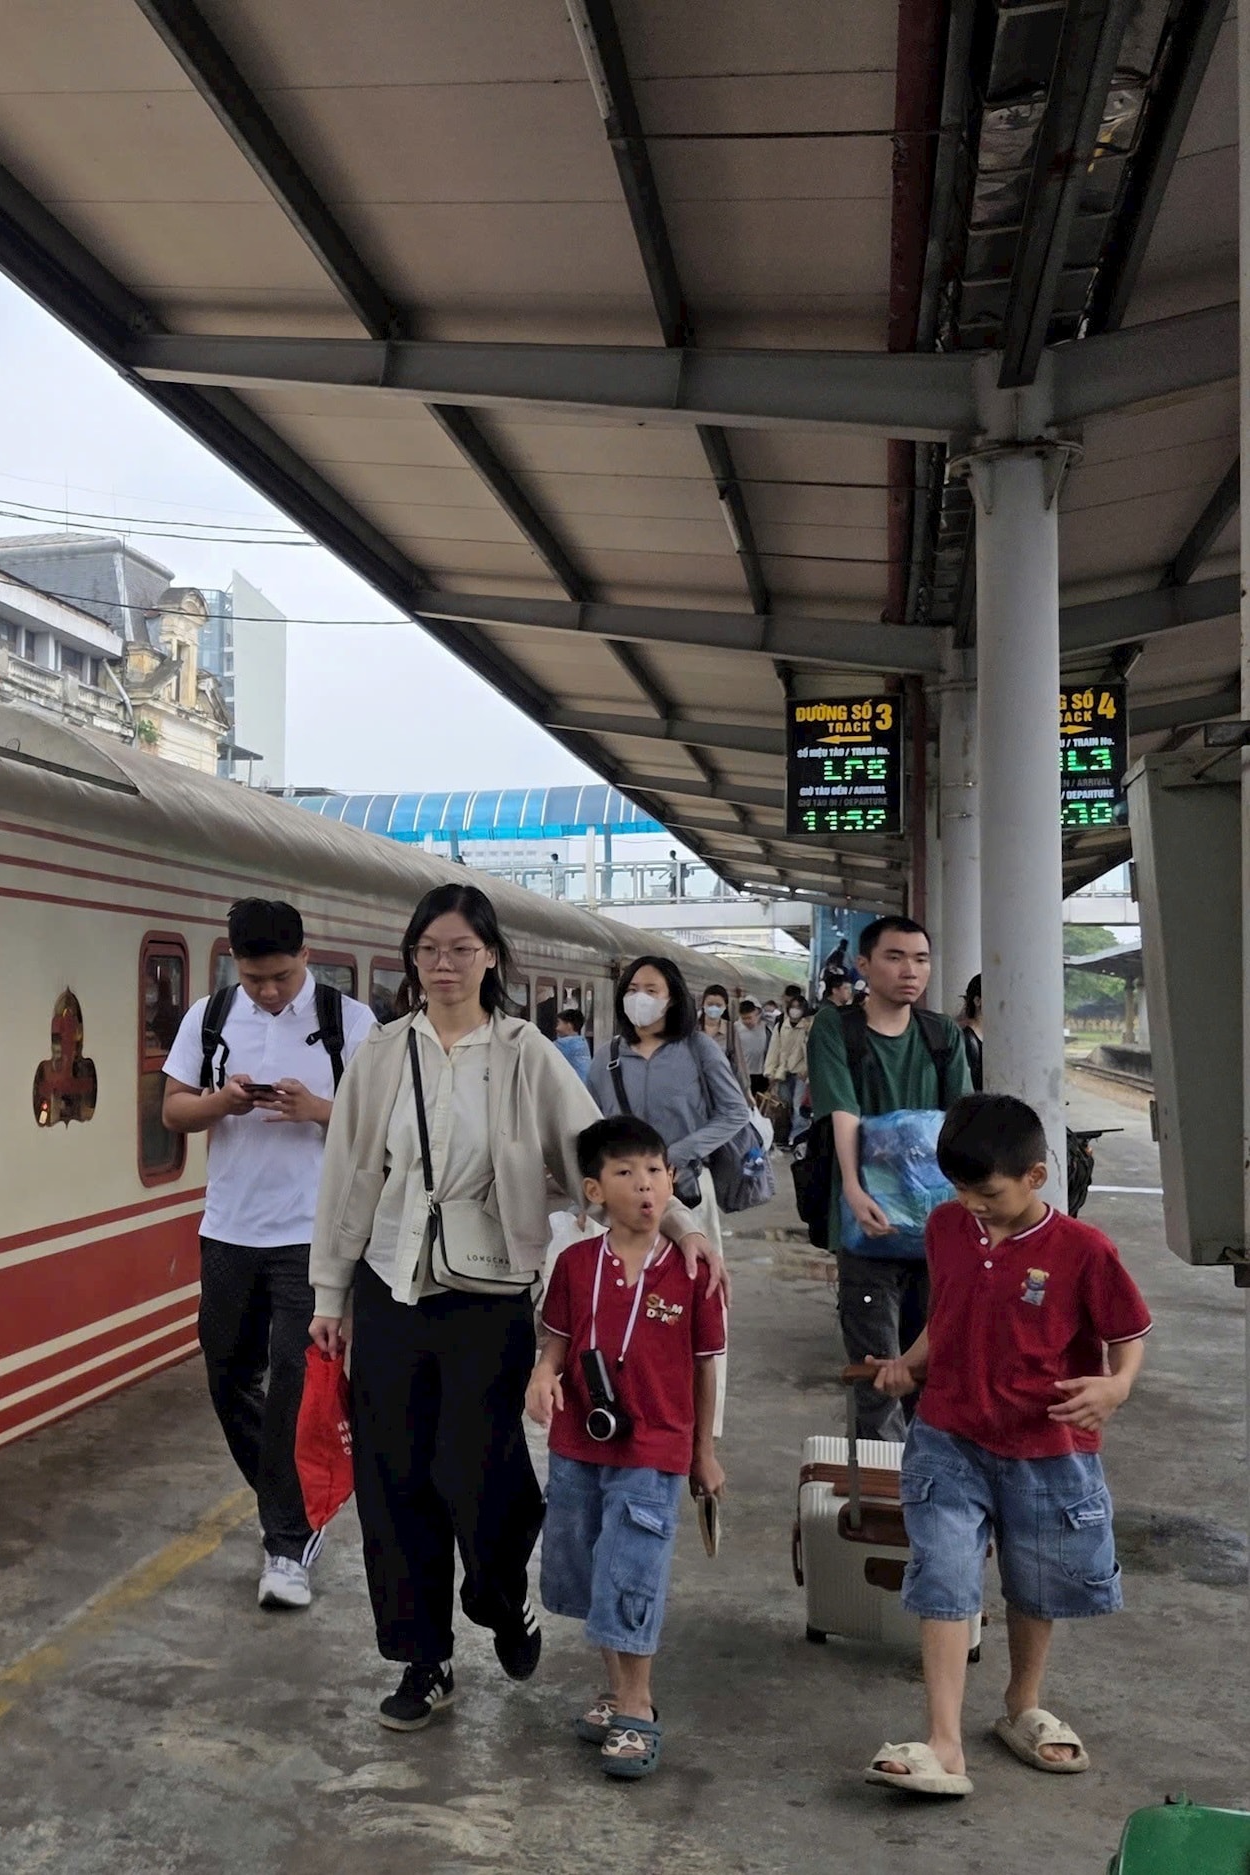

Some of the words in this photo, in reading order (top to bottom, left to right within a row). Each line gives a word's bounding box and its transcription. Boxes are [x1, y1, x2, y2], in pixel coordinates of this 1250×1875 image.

[1097, 692, 1117, 719] 4
[875, 703, 892, 730] 3
[1060, 710, 1092, 723] ACK
[828, 721, 870, 733] TRACK
[1066, 789, 1115, 800] DEPARTURE
[467, 1254, 510, 1265] LONGCHA
